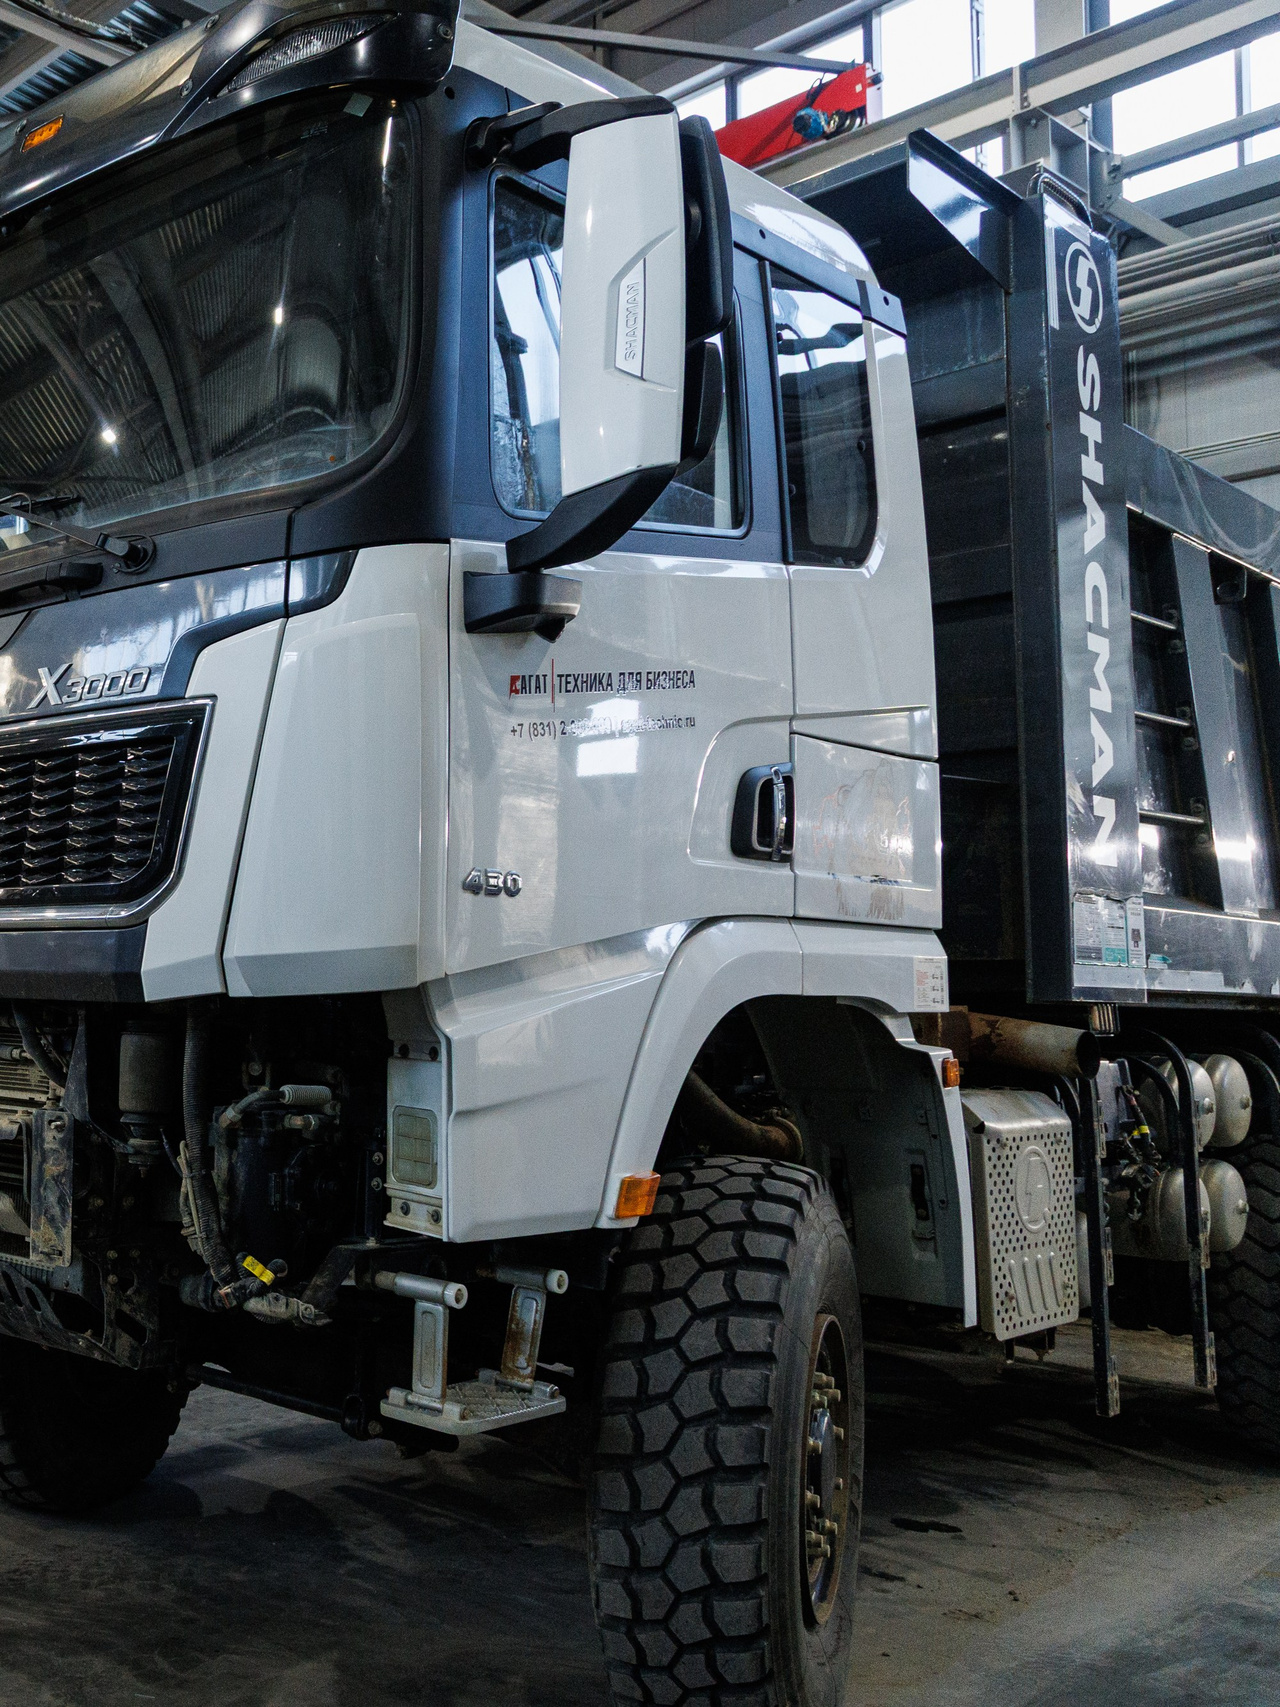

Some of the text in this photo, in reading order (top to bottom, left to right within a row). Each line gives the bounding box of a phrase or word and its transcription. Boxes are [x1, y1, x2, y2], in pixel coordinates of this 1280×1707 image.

[624, 281, 640, 361] SHACMAN
[1077, 345, 1118, 867] SHACMAN
[26, 663, 151, 710] X3000
[557, 672, 613, 693] ТЕХНИКА
[617, 671, 642, 694] ДЛЯ
[646, 669, 696, 691] БИЗНЕСА
[510, 723, 524, 738] +7
[528, 721, 557, 741] (831)
